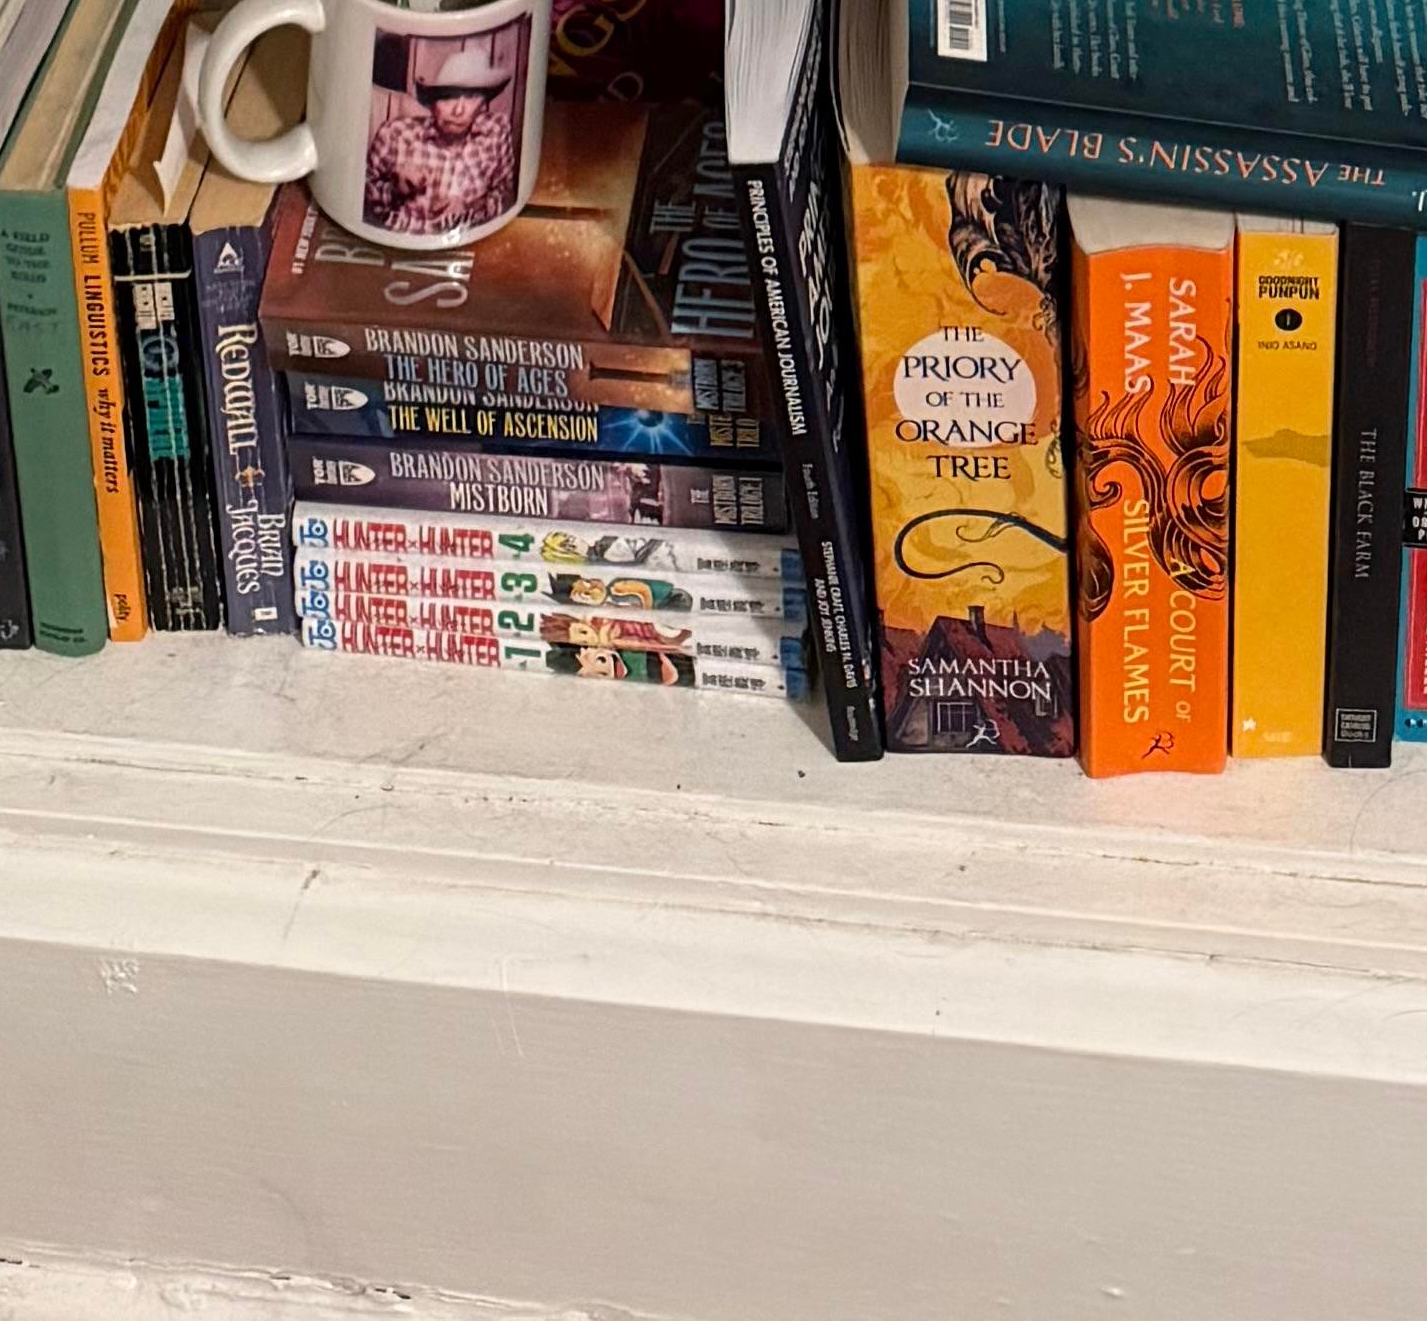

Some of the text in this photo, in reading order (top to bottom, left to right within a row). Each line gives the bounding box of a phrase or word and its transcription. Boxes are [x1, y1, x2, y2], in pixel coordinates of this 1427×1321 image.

[986, 119, 1103, 159] BLADE
[84, 275, 109, 378] LINGUISTICS
[365, 328, 583, 371] BRANDON SANDERSON
[902, 354, 1022, 385] PRIORY
[895, 418, 1038, 449] ORANGE
[449, 482, 548, 515] MISTBORN
[1355, 471, 1375, 579] BLACK FARM
[1123, 498, 1150, 724] SILVER FLAMES
[908, 657, 1050, 682] SAMANTHA
[908, 677, 1052, 704] SHANNON
